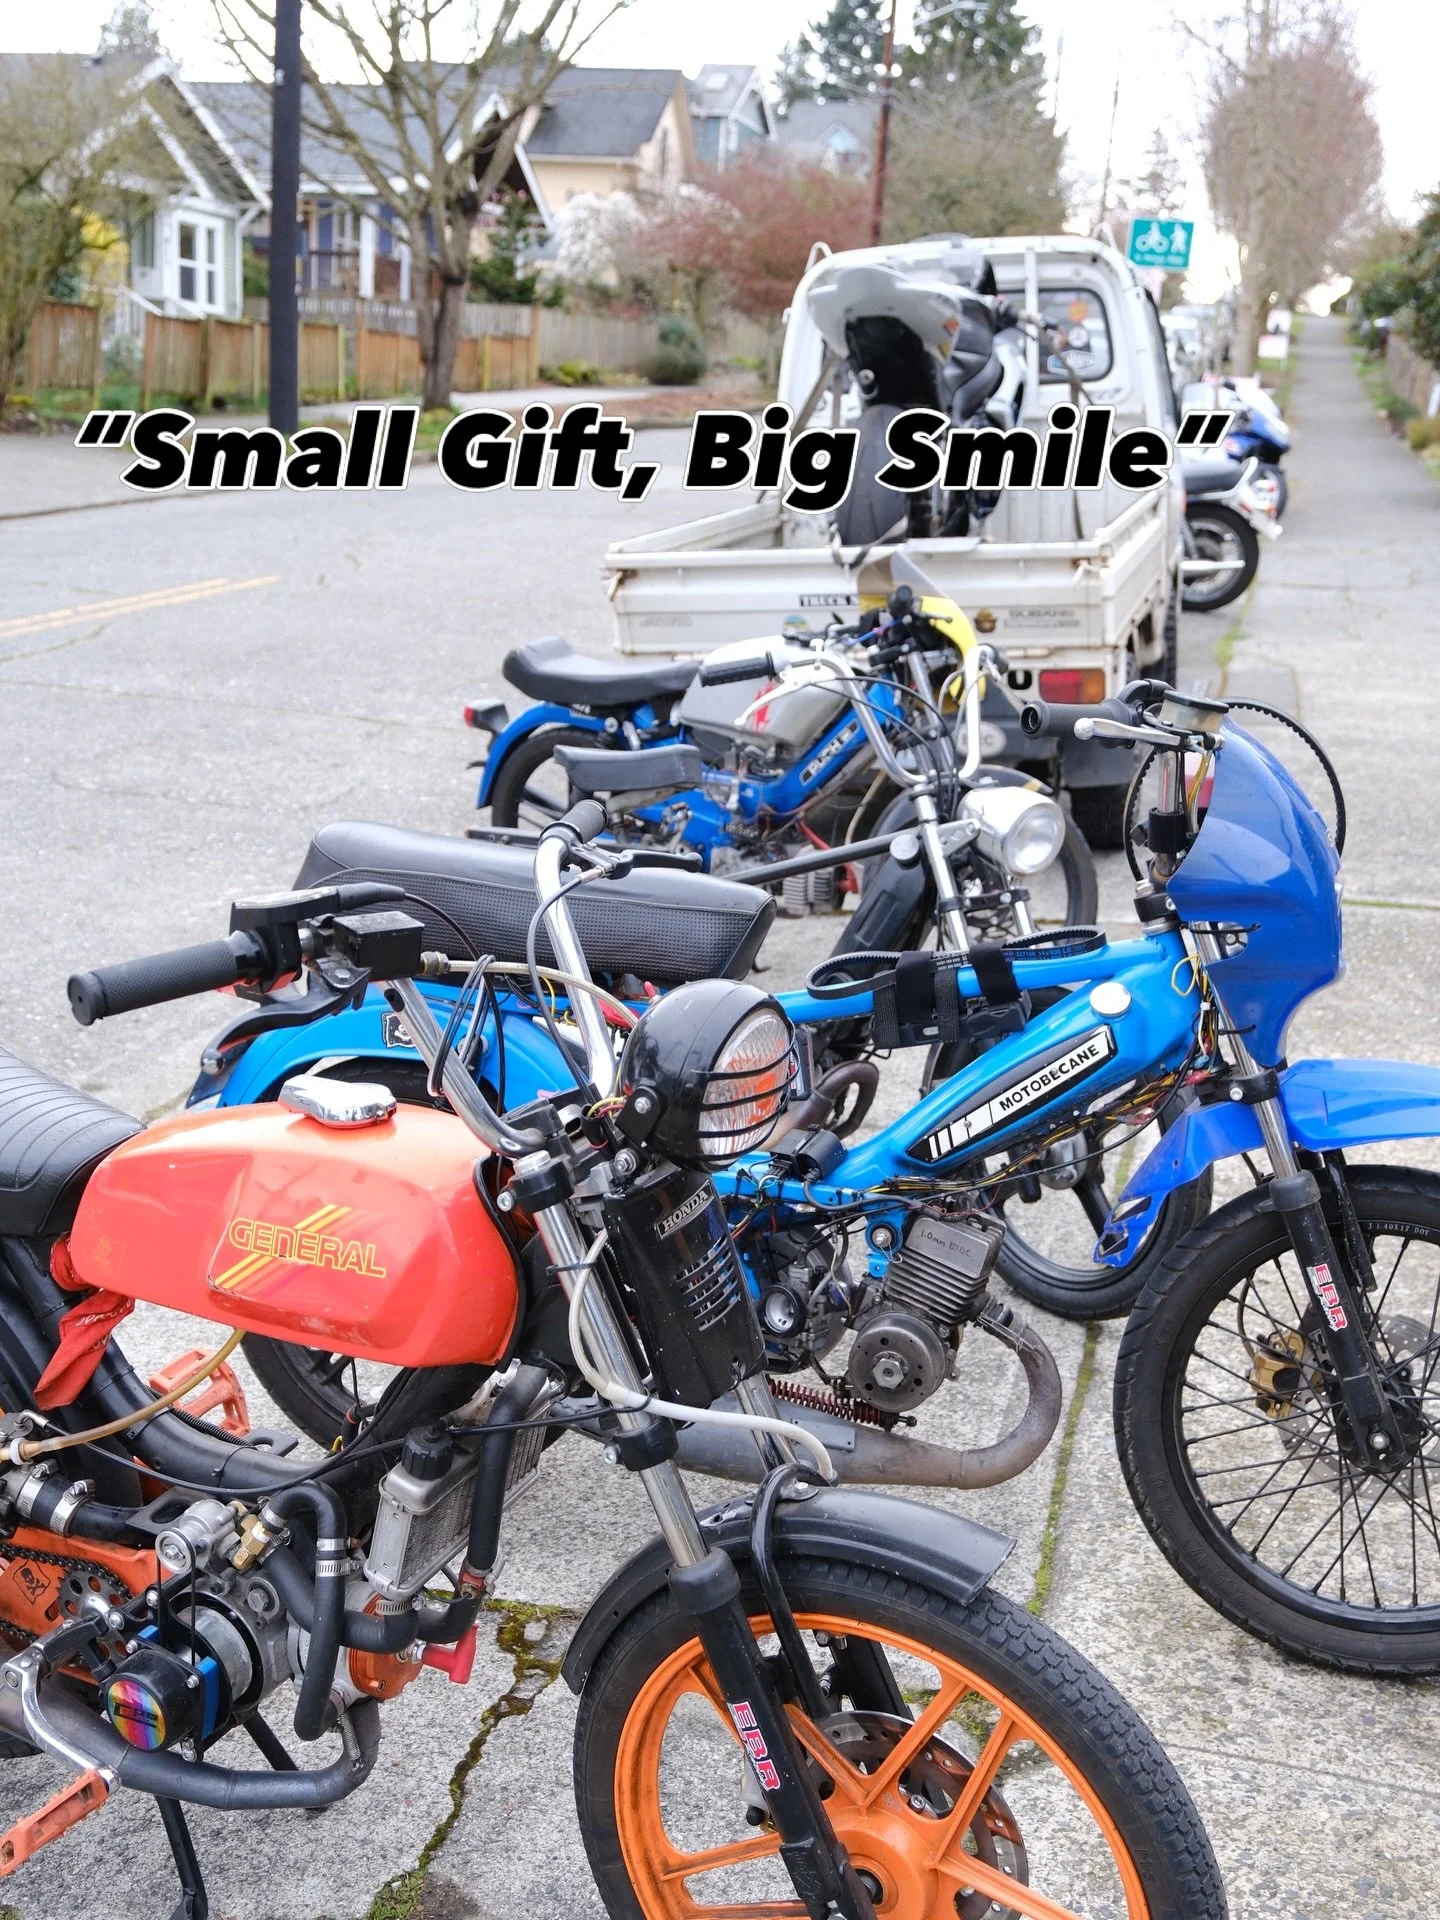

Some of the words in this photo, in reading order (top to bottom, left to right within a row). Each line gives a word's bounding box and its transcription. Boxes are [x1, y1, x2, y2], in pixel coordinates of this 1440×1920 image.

[998, 1044, 1100, 1112] MOTOBECANE
[661, 1189, 709, 1232] HONDA
[1414, 1227, 1430, 1237] DOT
[228, 1217, 387, 1279] GENERAL
[1313, 1262, 1349, 1330] EBR
[732, 1700, 781, 1790] EBR
